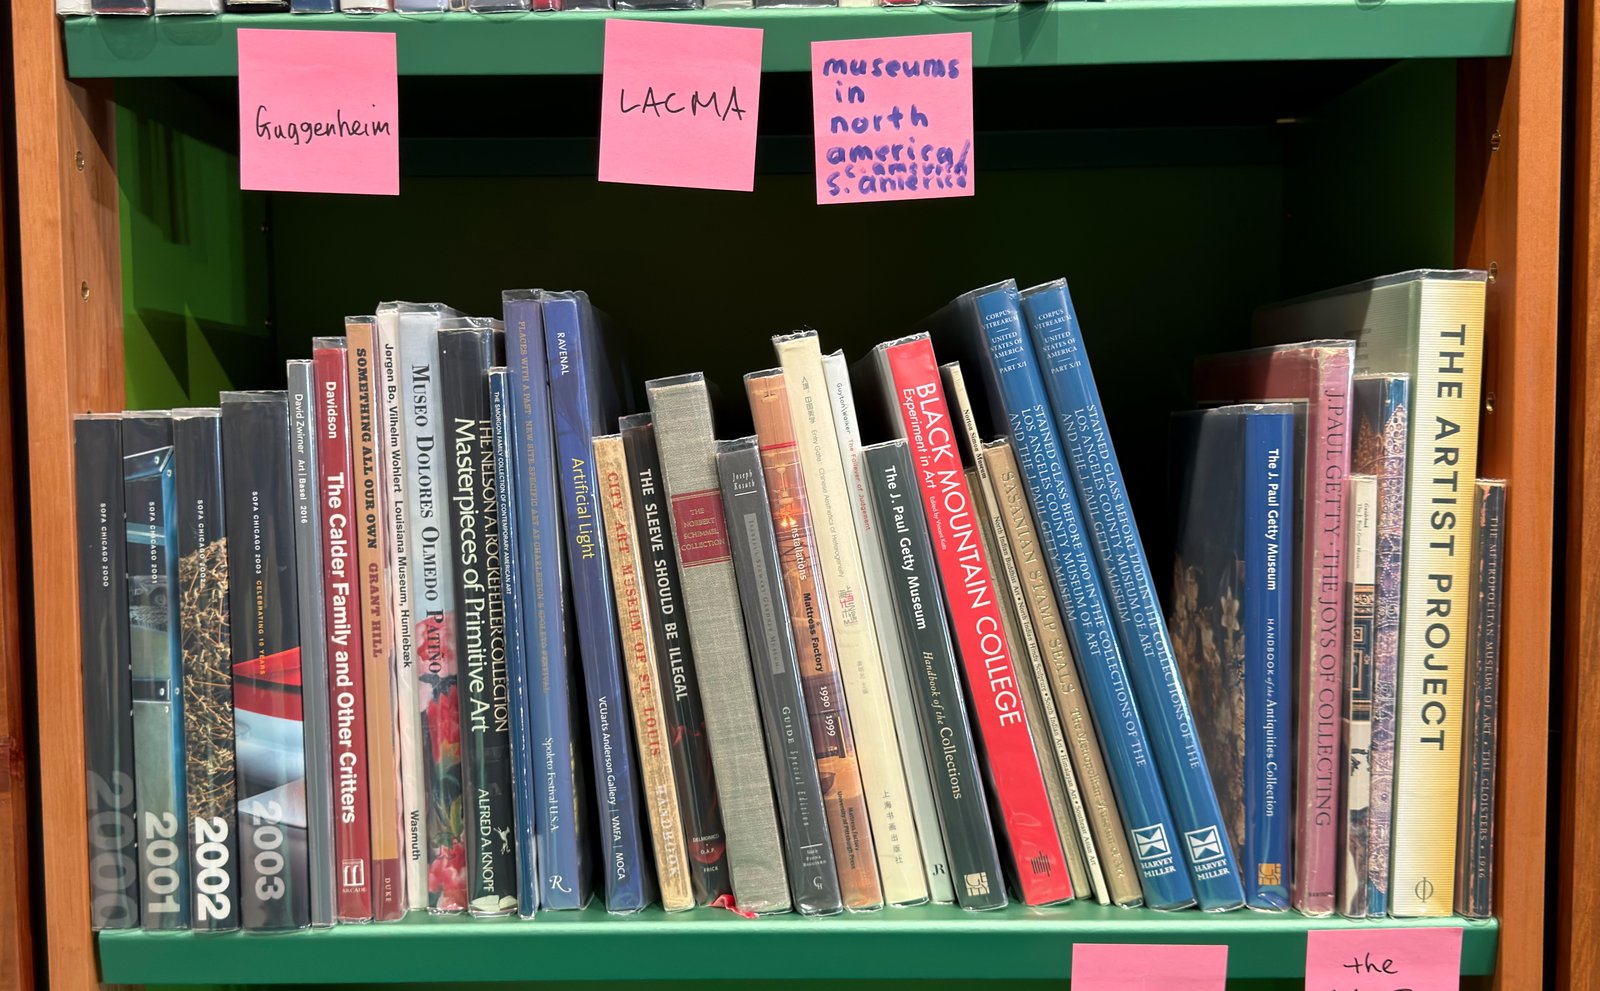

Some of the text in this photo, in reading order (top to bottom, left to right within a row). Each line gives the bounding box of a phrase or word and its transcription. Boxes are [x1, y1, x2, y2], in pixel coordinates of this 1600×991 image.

[823, 58, 960, 79] museums
[836, 80, 865, 104] in
[256, 104, 390, 145] Guggenheim
[620, 86, 746, 121] LACMA
[830, 104, 928, 134] north
[557, 332, 569, 375] RAVENAL
[295, 394, 305, 418] David
[326, 381, 338, 438] Davidson
[296, 420, 306, 453] Zwirner
[900, 387, 937, 489] Experiment in Art
[963, 409, 987, 479] Norton Simon Museum
[1268, 449, 1279, 468] The
[357, 348, 383, 658] SOMETHING ALL OUR OWN GRANT HILL
[384, 343, 412, 668] Jørgen Bo, Vilhelm Wohlert Louisiana Museum, Humlebæk
[480, 452, 497, 512] NELSON
[571, 458, 596, 559] Artificial Light
[607, 472, 622, 510] CITY
[1268, 484, 1278, 506] Paul
[1324, 465, 1342, 536] GETTY
[484, 516, 496, 531] A.
[614, 521, 629, 553] ART
[883, 465, 929, 629] The J. Paul Getty Museum
[1021, 408, 1101, 657] LOS ANGELES COUNTY MUSEUM OF ART
[1264, 510, 1278, 540] Getty
[1420, 324, 1466, 750] THE ARTIST PROJECT
[1489, 516, 1499, 537] THE
[454, 418, 491, 732] Masterpieces of Primitive Art
[915, 382, 1021, 726] BLACK MOUNTAIN COLLEGE
[1267, 543, 1277, 590] Museum
[1322, 549, 1340, 593] THE
[485, 534, 504, 634] ROCKEFELLER
[621, 564, 641, 631] MUSEUM
[639, 468, 687, 700] THE SLEEVE SHOULD BE ILLEGAL
[790, 524, 824, 672] Installations Mattress Factory
[1000, 471, 1074, 695] SASANIAN STAMP SEALS
[1032, 403, 1146, 767] STAINED GLASS BEFORE 1700 IN THE COLLECTIONS OF THE
[1486, 544, 1498, 636] METROPOLITAN
[327, 472, 357, 823] The Calder Family and Other Critters
[1318, 597, 1338, 647] JOYS
[633, 642, 646, 663] OF
[1320, 654, 1336, 682] OF
[1485, 642, 1493, 690] MUSEUM
[491, 637, 508, 732] COLLECTION
[819, 685, 835, 736] 1990 1999
[1484, 695, 1492, 709] OF
[643, 707, 660, 756] LOUIS
[922, 650, 966, 799] Handbook of the Collections
[1263, 699, 1277, 758] Antiquities
[1315, 688, 1336, 826] COLLECTING
[598, 696, 626, 880] VCUarts Anderson Gallery VMFA MOCA
[1266, 761, 1277, 817] Collection
[1480, 778, 1488, 840] CLOISTERS
[86, 770, 138, 927] 2000
[145, 811, 180, 913] 2001
[252, 800, 285, 900] 2003
[410, 810, 421, 860] Wasmuth
[478, 788, 494, 892] ALFRED A. KNOPF
[1141, 856, 1173, 869] HARVEY
[194, 816, 231, 920] 2002
[1144, 866, 1176, 878] MILLER
[1194, 859, 1227, 872] HARVEY
[1198, 868, 1230, 880] MILLER
[1343, 952, 1398, 974] the
